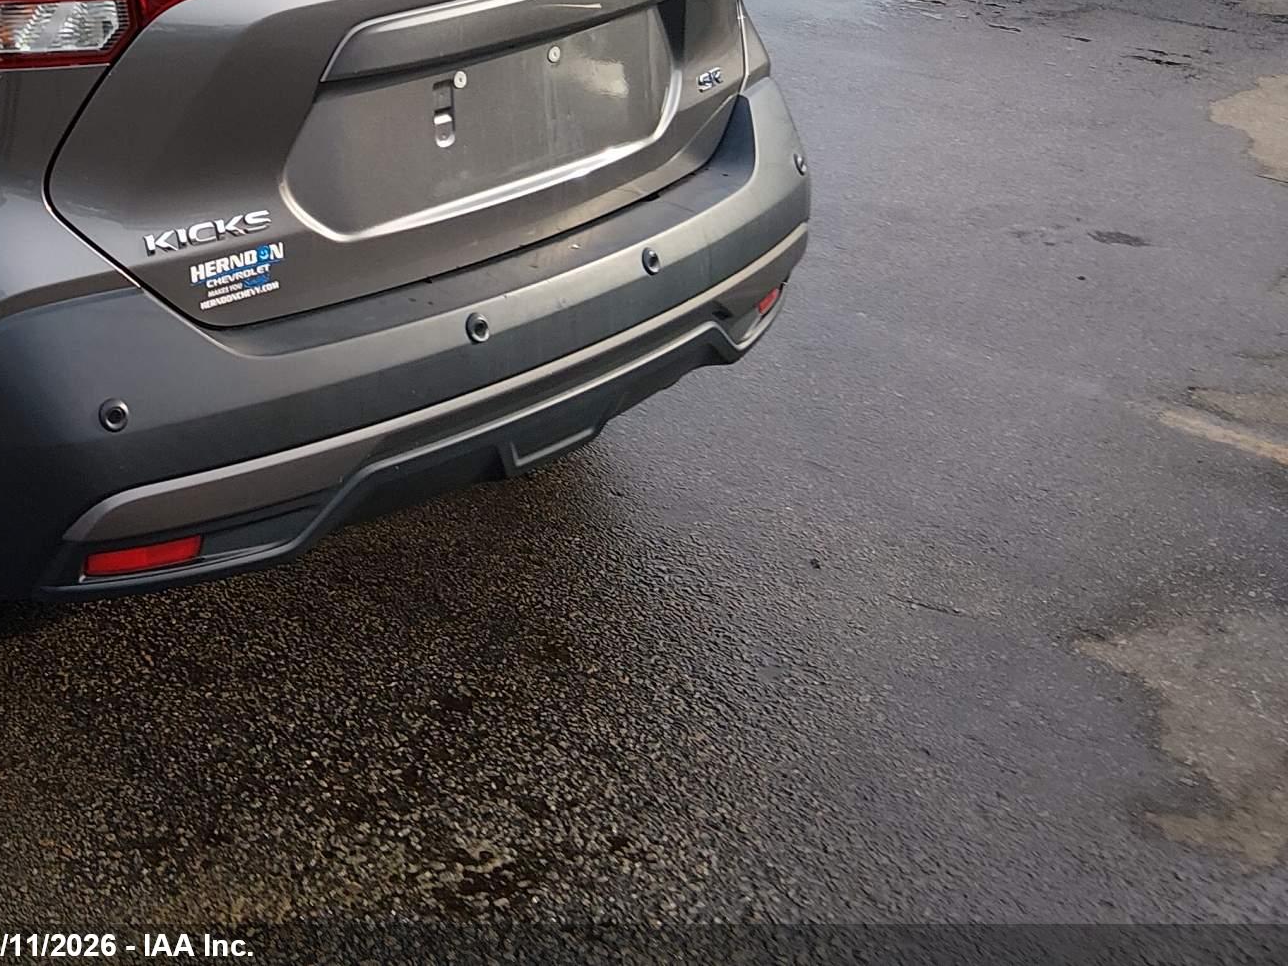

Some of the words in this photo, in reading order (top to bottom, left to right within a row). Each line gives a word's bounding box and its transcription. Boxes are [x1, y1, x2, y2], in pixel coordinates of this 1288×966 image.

[144, 209, 272, 256] KICKS
[190, 241, 284, 283] HERNDON
[206, 264, 271, 289] CHEVROLET
